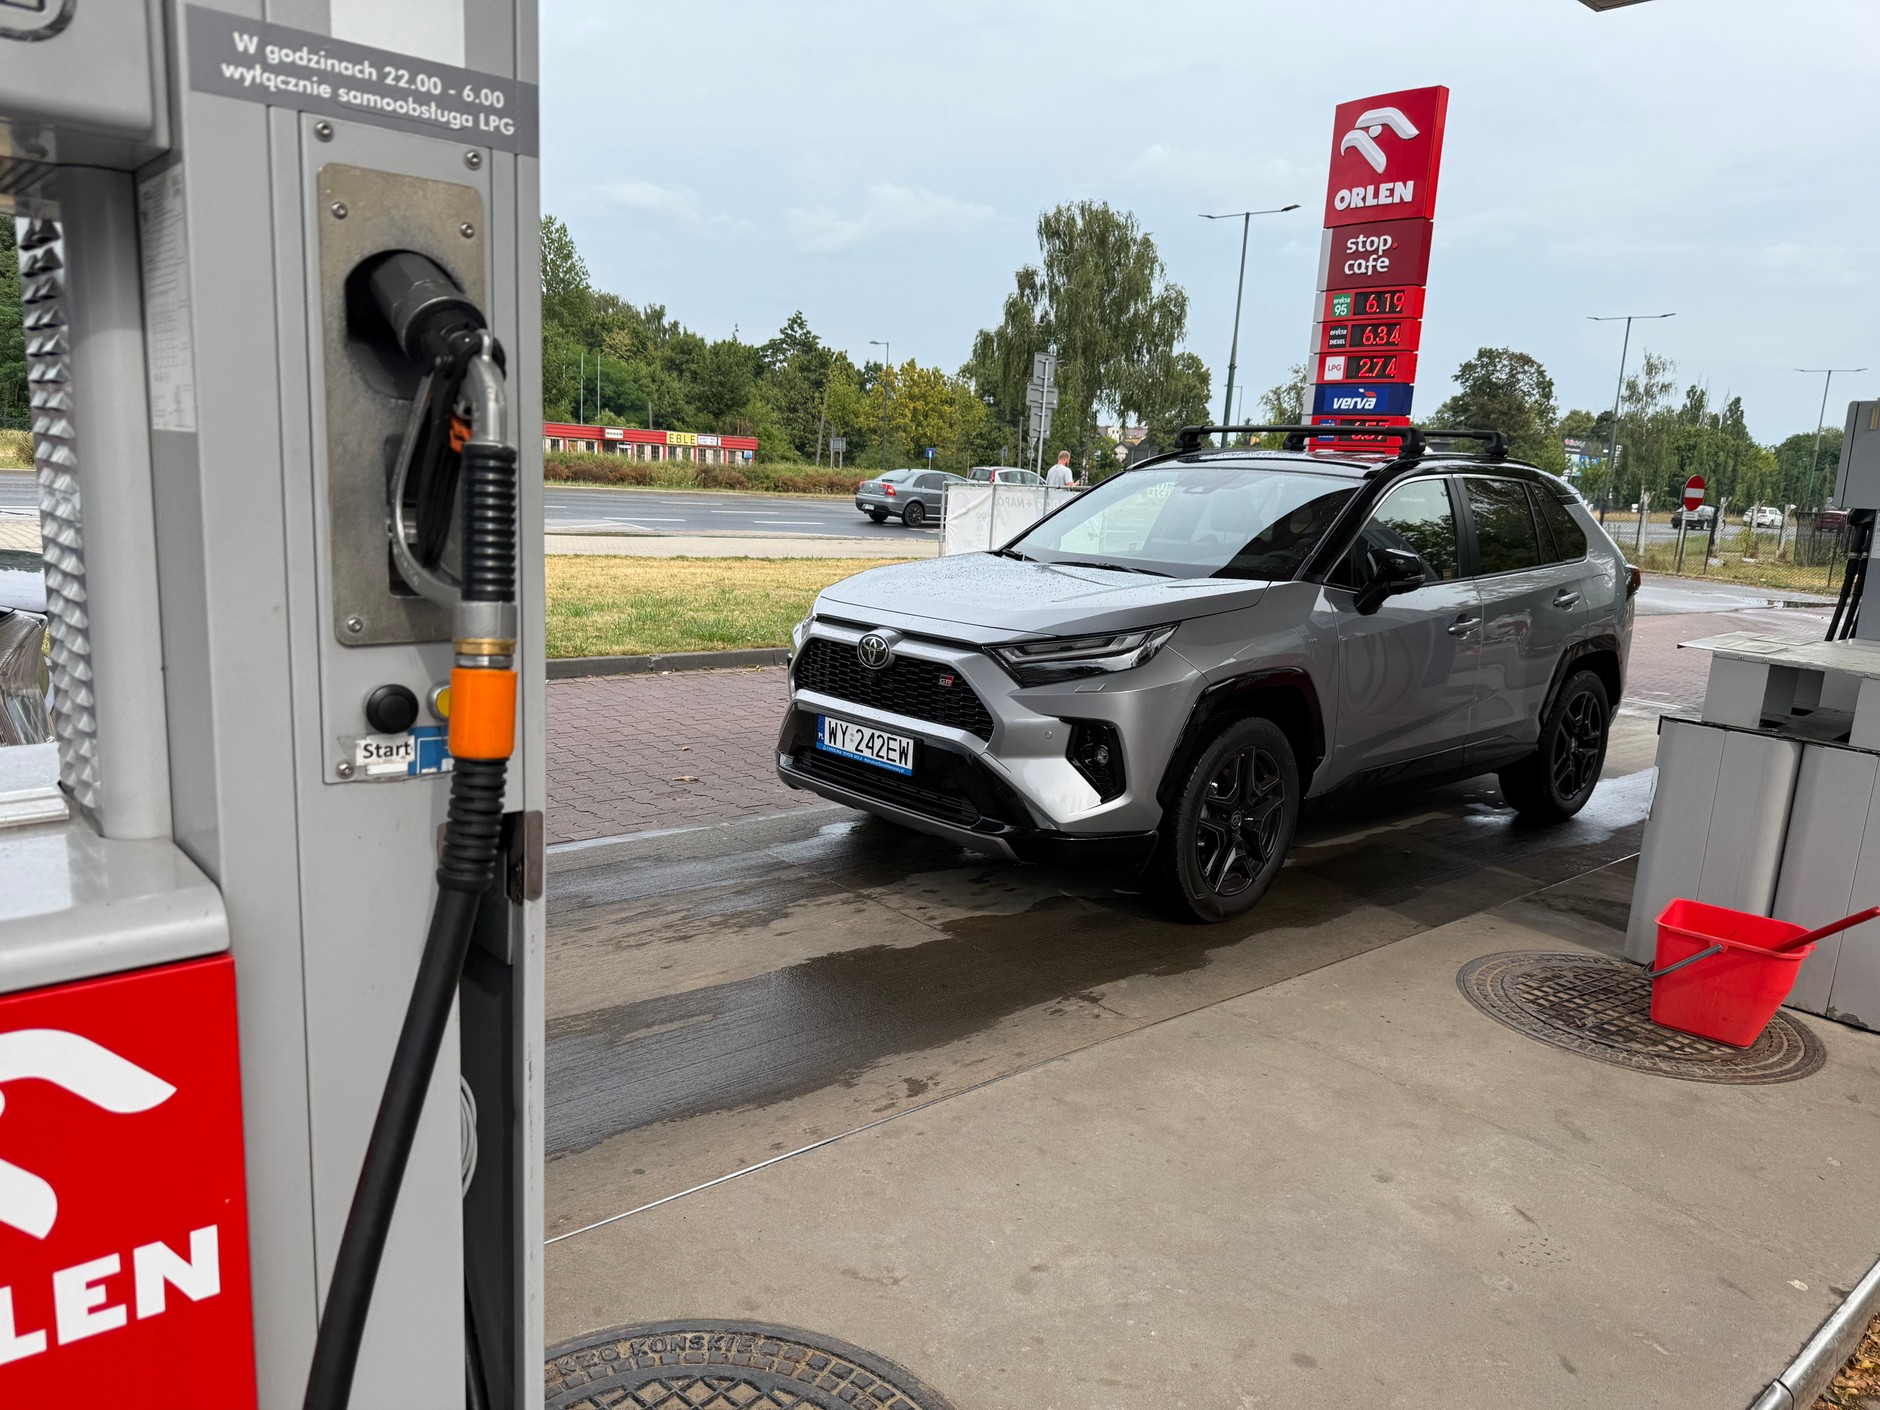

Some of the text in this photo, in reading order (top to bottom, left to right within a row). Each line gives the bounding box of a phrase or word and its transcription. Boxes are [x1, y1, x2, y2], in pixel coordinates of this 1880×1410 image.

[233, 32, 258, 54] W
[265, 43, 378, 80] godzinach
[384, 66, 443, 96] 22.00
[462, 84, 506, 109] 6.00
[221, 62, 516, 136] wyłącznie samoobsługa LPG
[1334, 180, 1415, 212] ORLEN
[1344, 256, 1391, 277] cafe
[1334, 304, 1348, 316] 95
[1366, 292, 1405, 313] 6.19
[1329, 338, 1346, 346] DIESEL
[1362, 325, 1401, 345] 6.34
[1327, 364, 1341, 372] LPG
[1359, 358, 1397, 377] 2.74
[1333, 397, 1377, 410] verva
[818, 732, 824, 740] PL
[828, 720, 849, 749] WY
[855, 728, 910, 766] 242EW
[363, 741, 412, 759] Start
